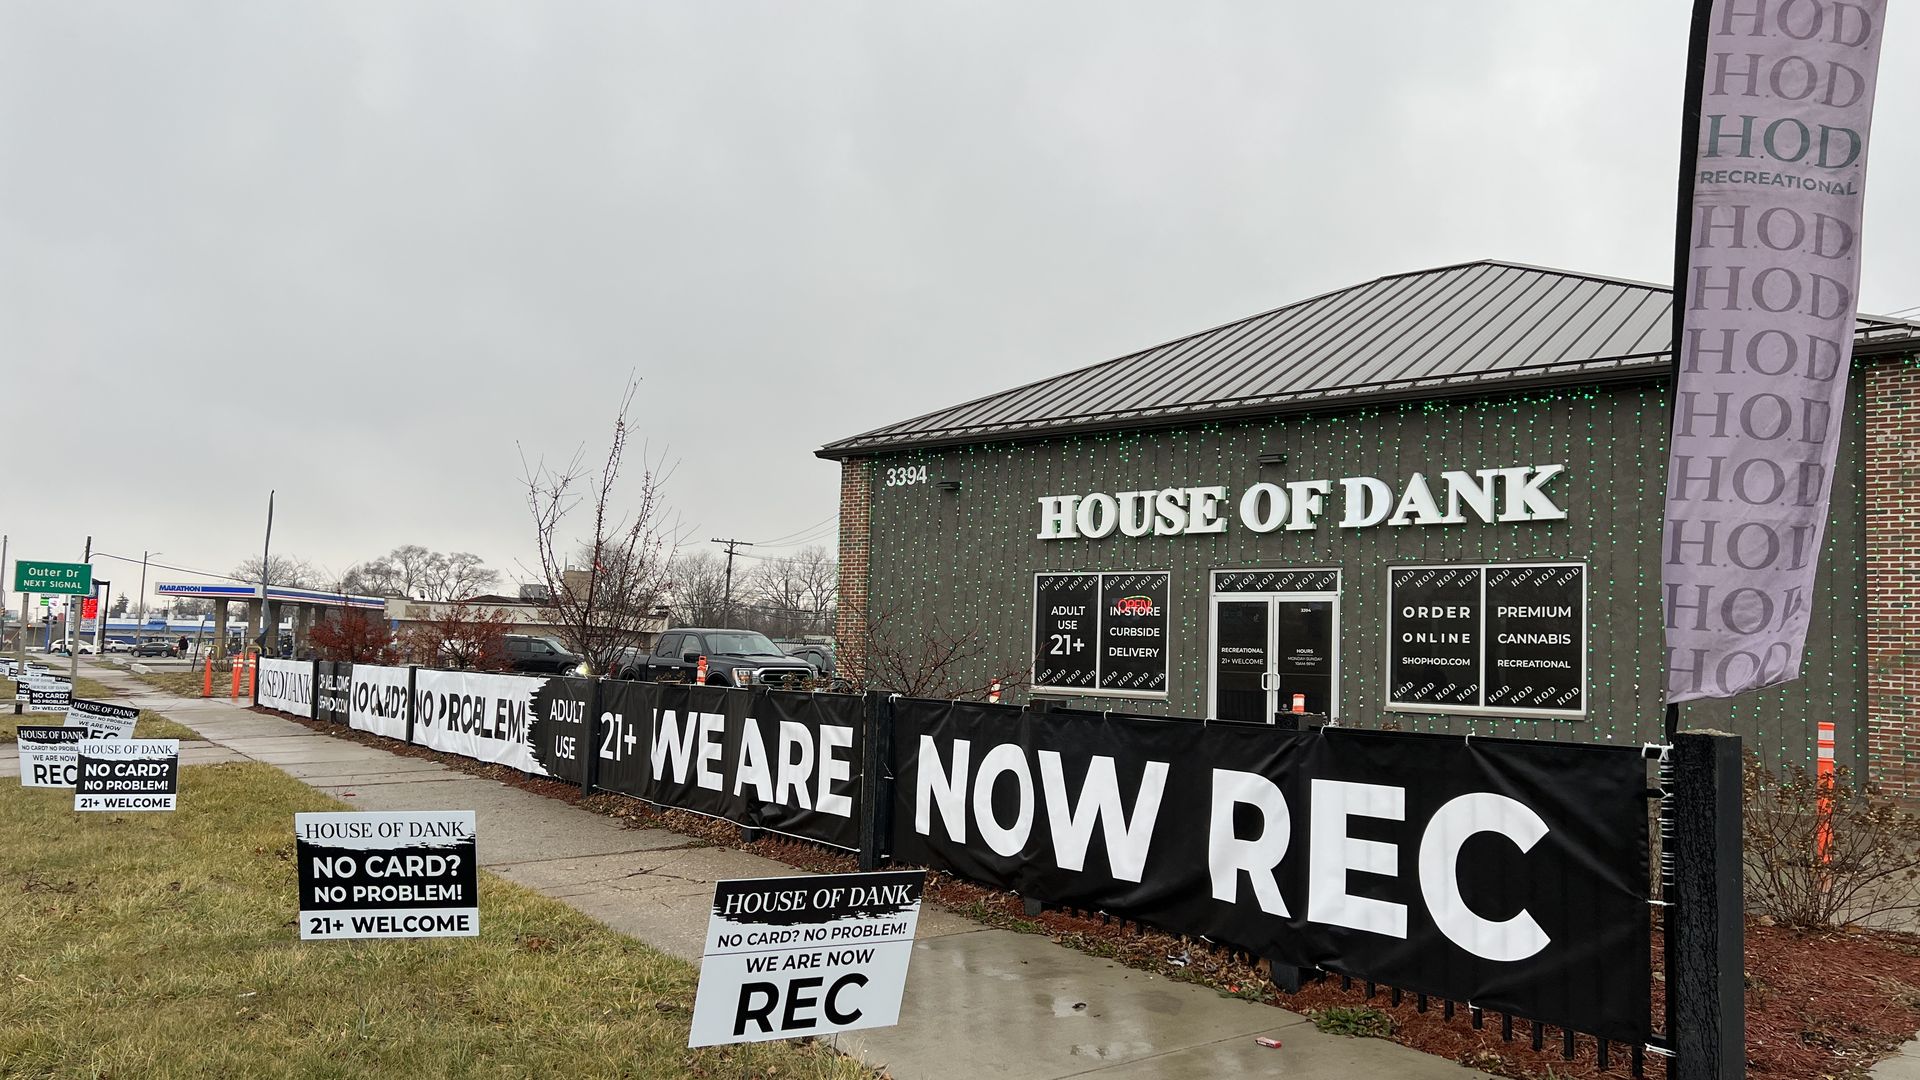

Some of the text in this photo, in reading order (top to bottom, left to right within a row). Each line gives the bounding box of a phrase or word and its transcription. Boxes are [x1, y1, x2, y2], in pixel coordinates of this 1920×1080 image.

[1703, 115, 1862, 169] H.O.D.
[1700, 170, 1857, 195] RECREATIONAL
[886, 466, 927, 486] 3394
[1037, 464, 1567, 540] HOUSE OF DANK
[28, 568, 79, 578] Outer Dr
[50, 580, 82, 588] SIGNAL
[1051, 606, 1085, 616] ADULT
[1402, 606, 1470, 618] ORDER
[1497, 606, 1571, 617] PREMIUM
[1058, 620, 1077, 629] USE
[1110, 627, 1160, 636] CURBSIDE
[1050, 634, 1085, 655] 21+
[1402, 632, 1470, 644] ONLINE
[1497, 634, 1571, 644] CANNABIS
[1109, 647, 1159, 657] DELIVERY
[1402, 657, 1470, 666] SHOPHOD.COM
[1497, 660, 1571, 668] RECREATIONAL
[74, 702, 136, 718] HOUSE OF DANK
[415, 689, 433, 728] NO
[550, 699, 586, 724] ADULT
[20, 730, 48, 738] HOUSE
[62, 731, 84, 739] DANK
[600, 711, 637, 761] 21+
[83, 745, 173, 754] HOUSE OF DANK
[555, 735, 576, 760] USE
[34, 764, 78, 785] REC
[85, 764, 169, 777] NO CARD?
[84, 781, 168, 790] NO PROBLEM!
[80, 798, 170, 808] 21+ WELCOME
[306, 822, 464, 839] HOUSE OF DANK
[651, 708, 1552, 963] WE ARE NOW REC
[313, 855, 461, 878] NO CARD?
[314, 884, 462, 902] NO PROBLEM!
[724, 884, 913, 914] HOUSE OF DANK
[310, 915, 469, 934] 21+ WELCOME
[718, 922, 907, 948] NO CARD? NO PROBLEM!
[746, 948, 875, 973] WE ARE NOW
[733, 972, 869, 1036] REC
